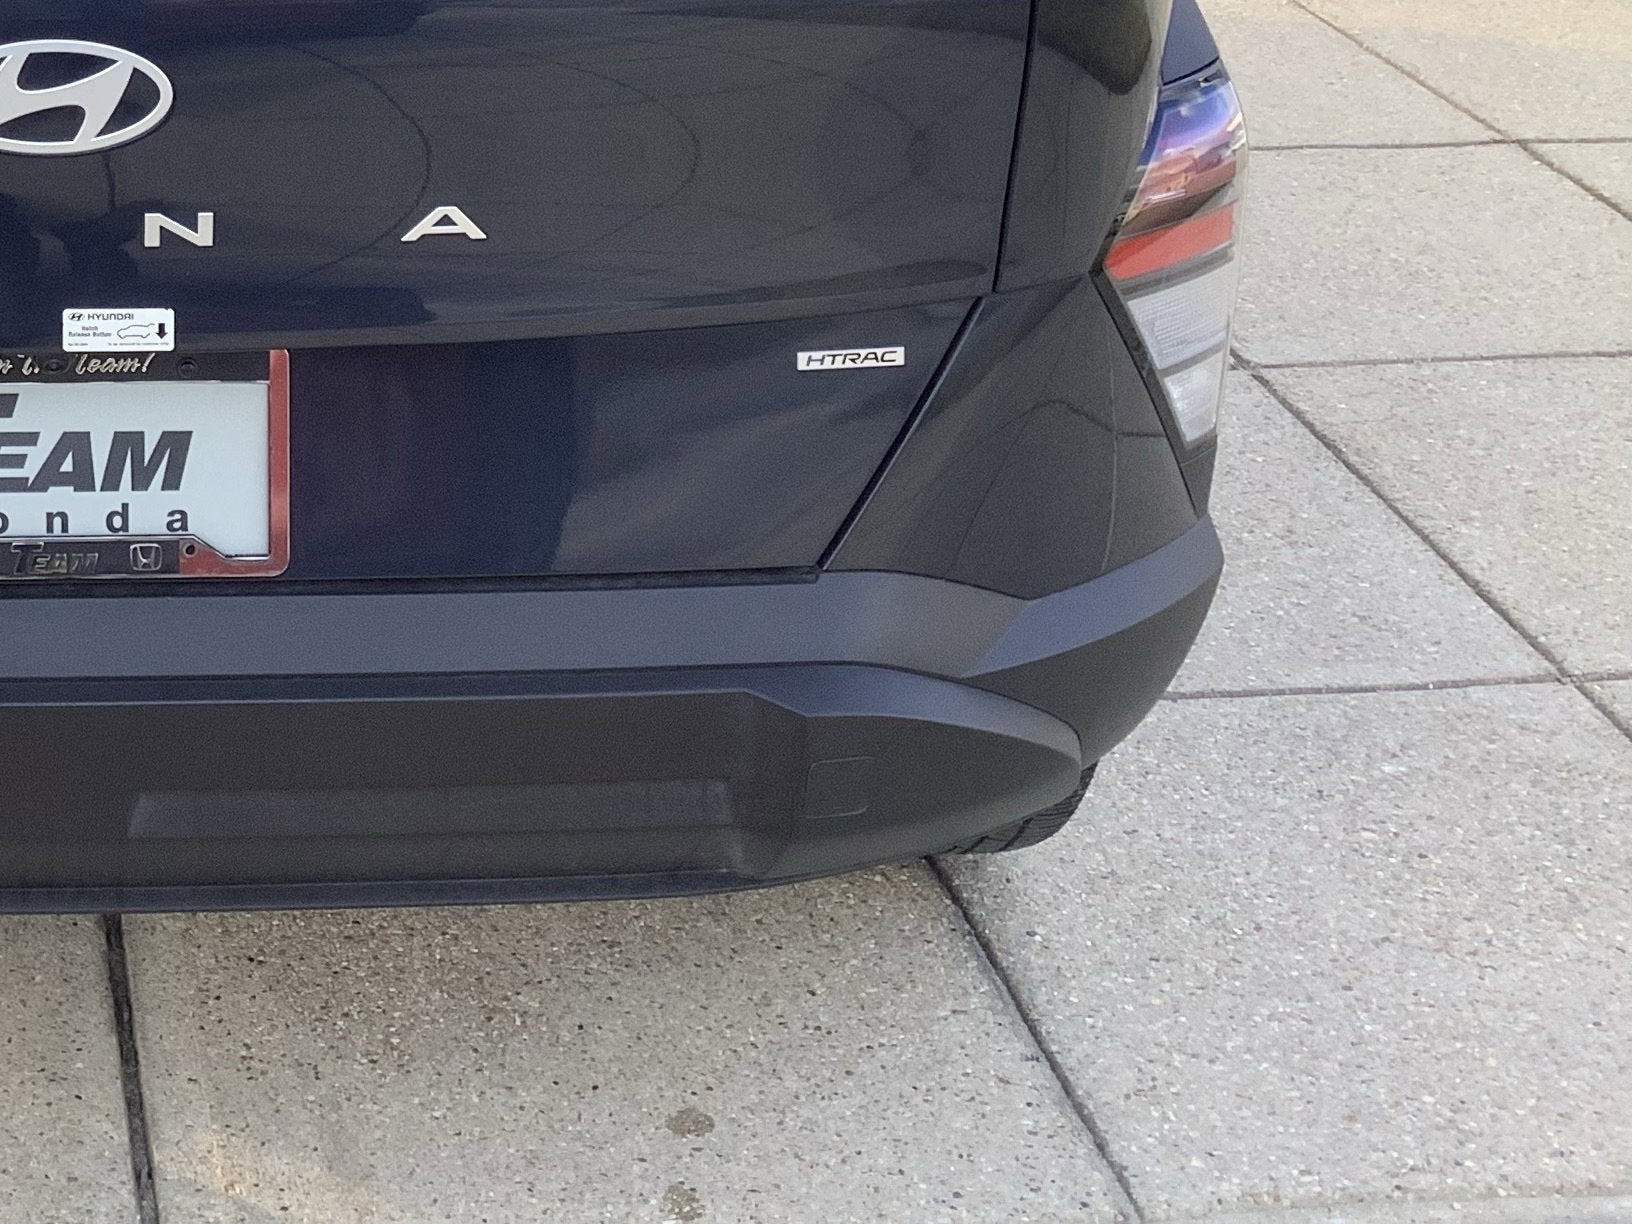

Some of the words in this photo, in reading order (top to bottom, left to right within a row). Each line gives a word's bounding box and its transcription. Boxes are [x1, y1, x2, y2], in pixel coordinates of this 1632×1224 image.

[87, 313, 134, 321] HYUNDAI
[806, 350, 897, 367] HTRAC
[10, 542, 99, 575] TEAM
